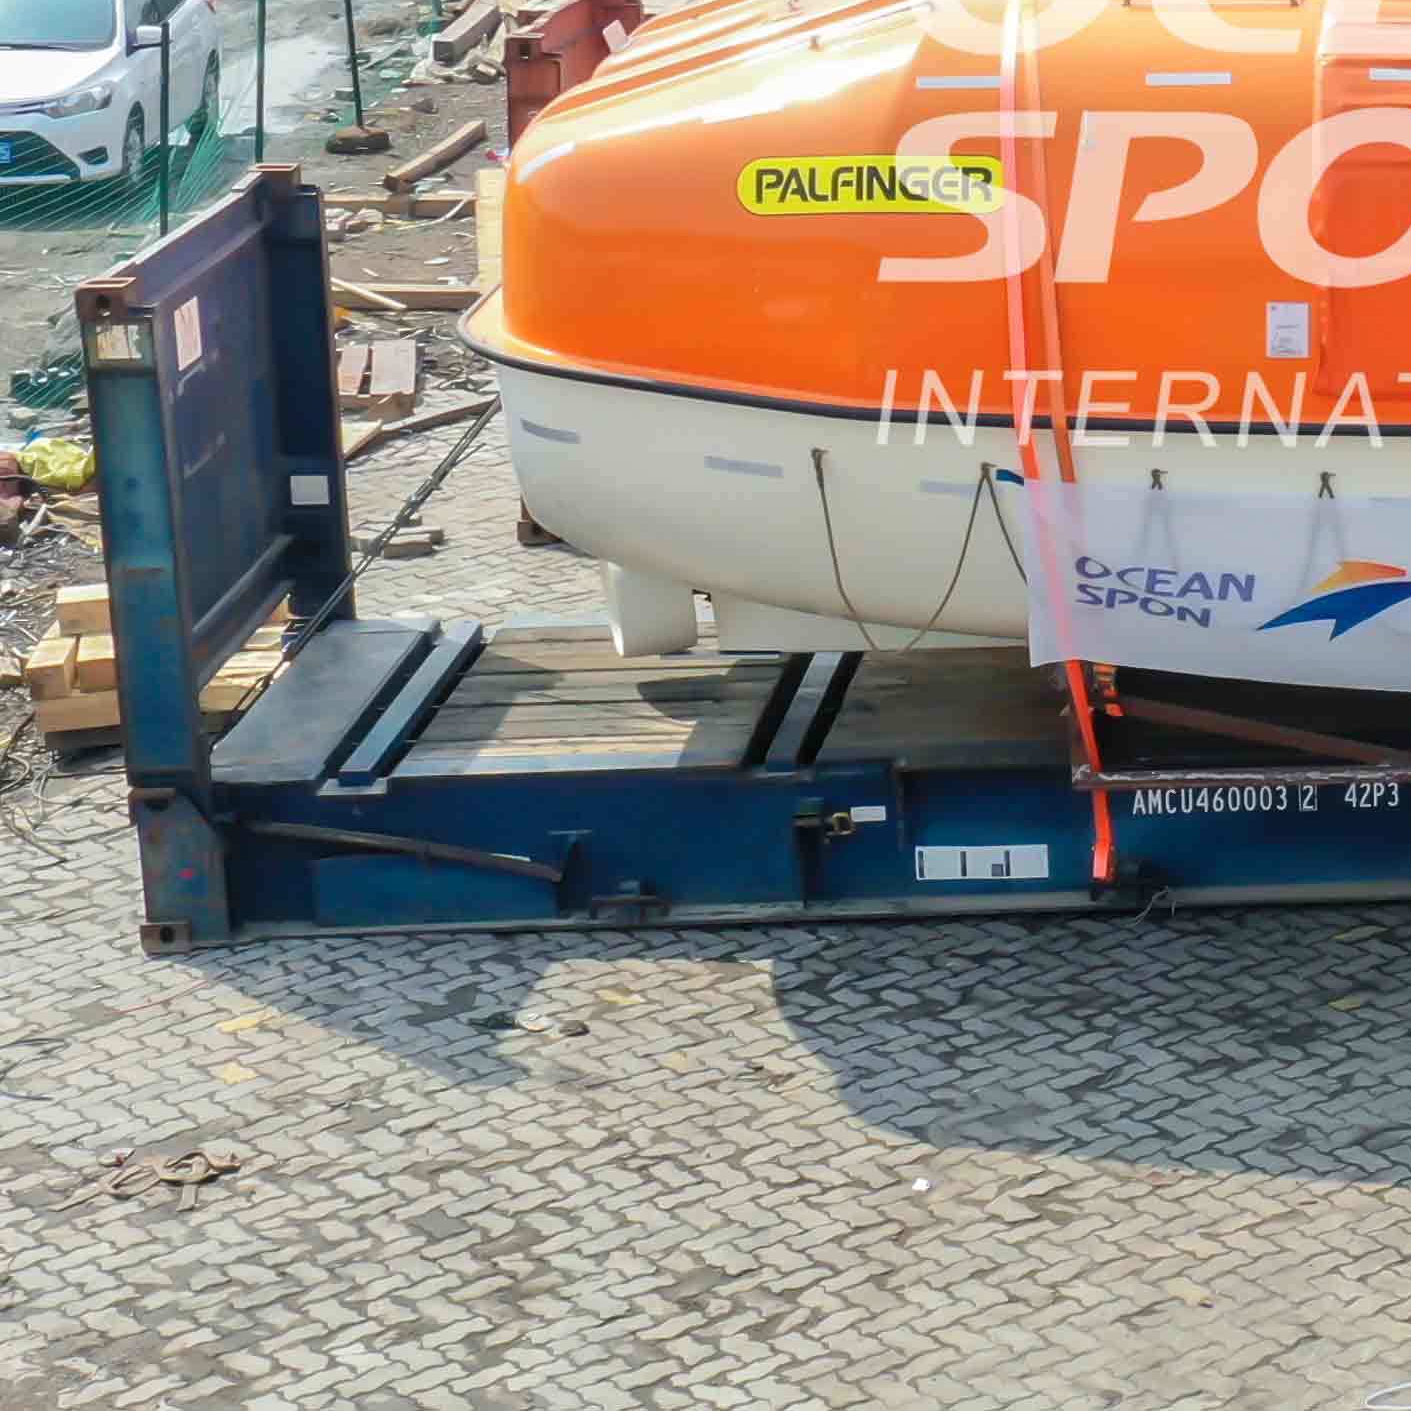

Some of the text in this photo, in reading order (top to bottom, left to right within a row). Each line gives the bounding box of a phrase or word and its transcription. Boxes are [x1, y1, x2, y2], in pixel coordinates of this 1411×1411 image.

[754, 165, 994, 205] PALFINGER
[1075, 555, 1256, 603] OCEAN
[1075, 583, 1212, 628] SPON
[1344, 782, 1400, 809] 42P3
